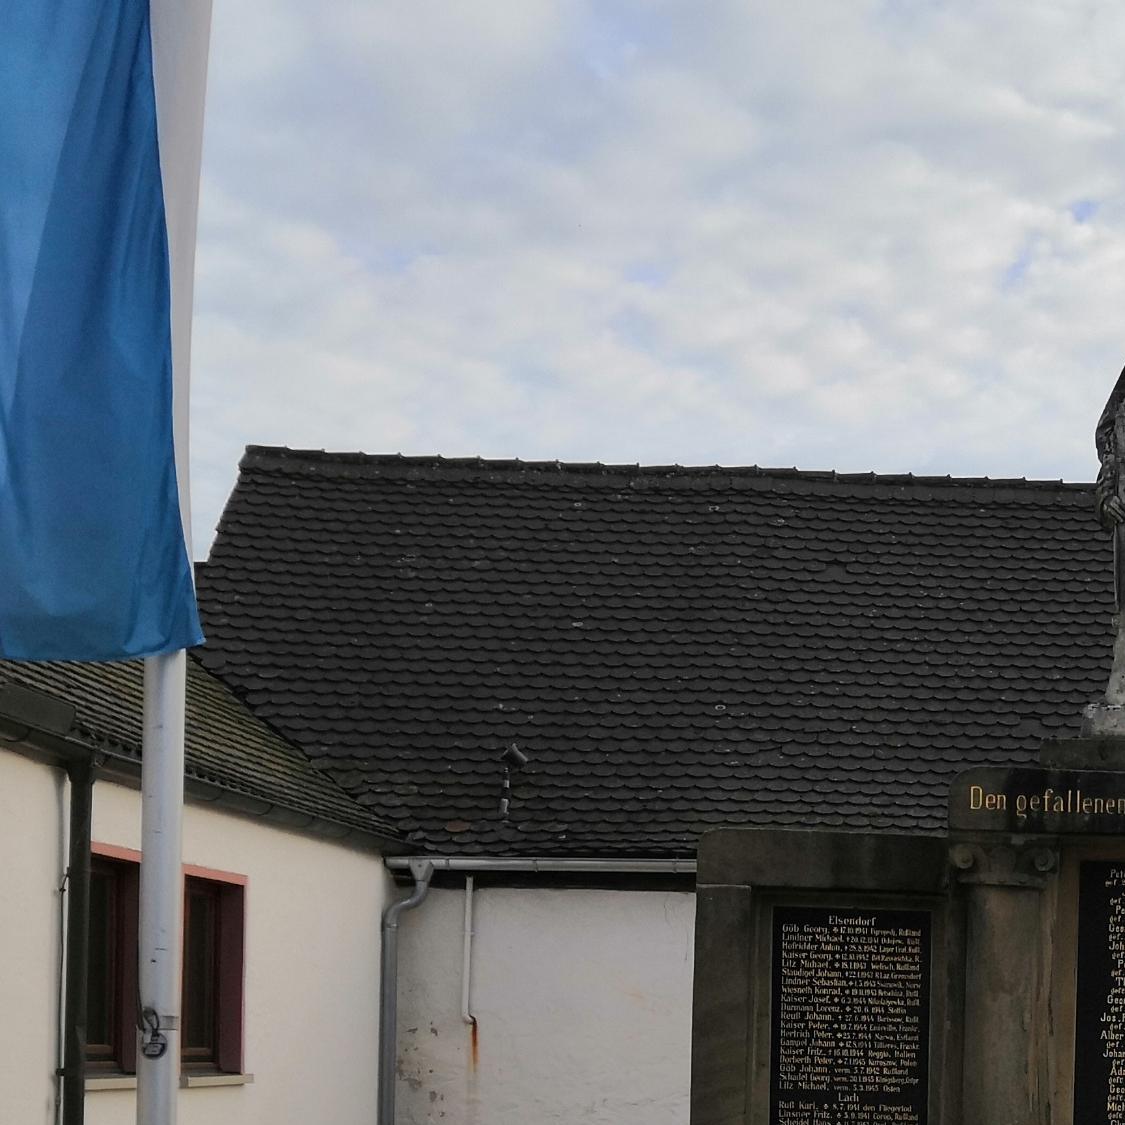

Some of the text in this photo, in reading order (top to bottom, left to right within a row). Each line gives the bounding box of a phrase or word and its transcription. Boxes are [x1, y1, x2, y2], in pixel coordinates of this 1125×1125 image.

[969, 786, 1007, 811] Den
[829, 915, 876, 926] Elsendorf
[783, 951, 810, 959] Kaiser
[781, 994, 805, 1002] Kaiser
[781, 1021, 805, 1029] Kaiser
[780, 1046, 805, 1055] Kaiser
[838, 1092, 859, 1102] Lach
